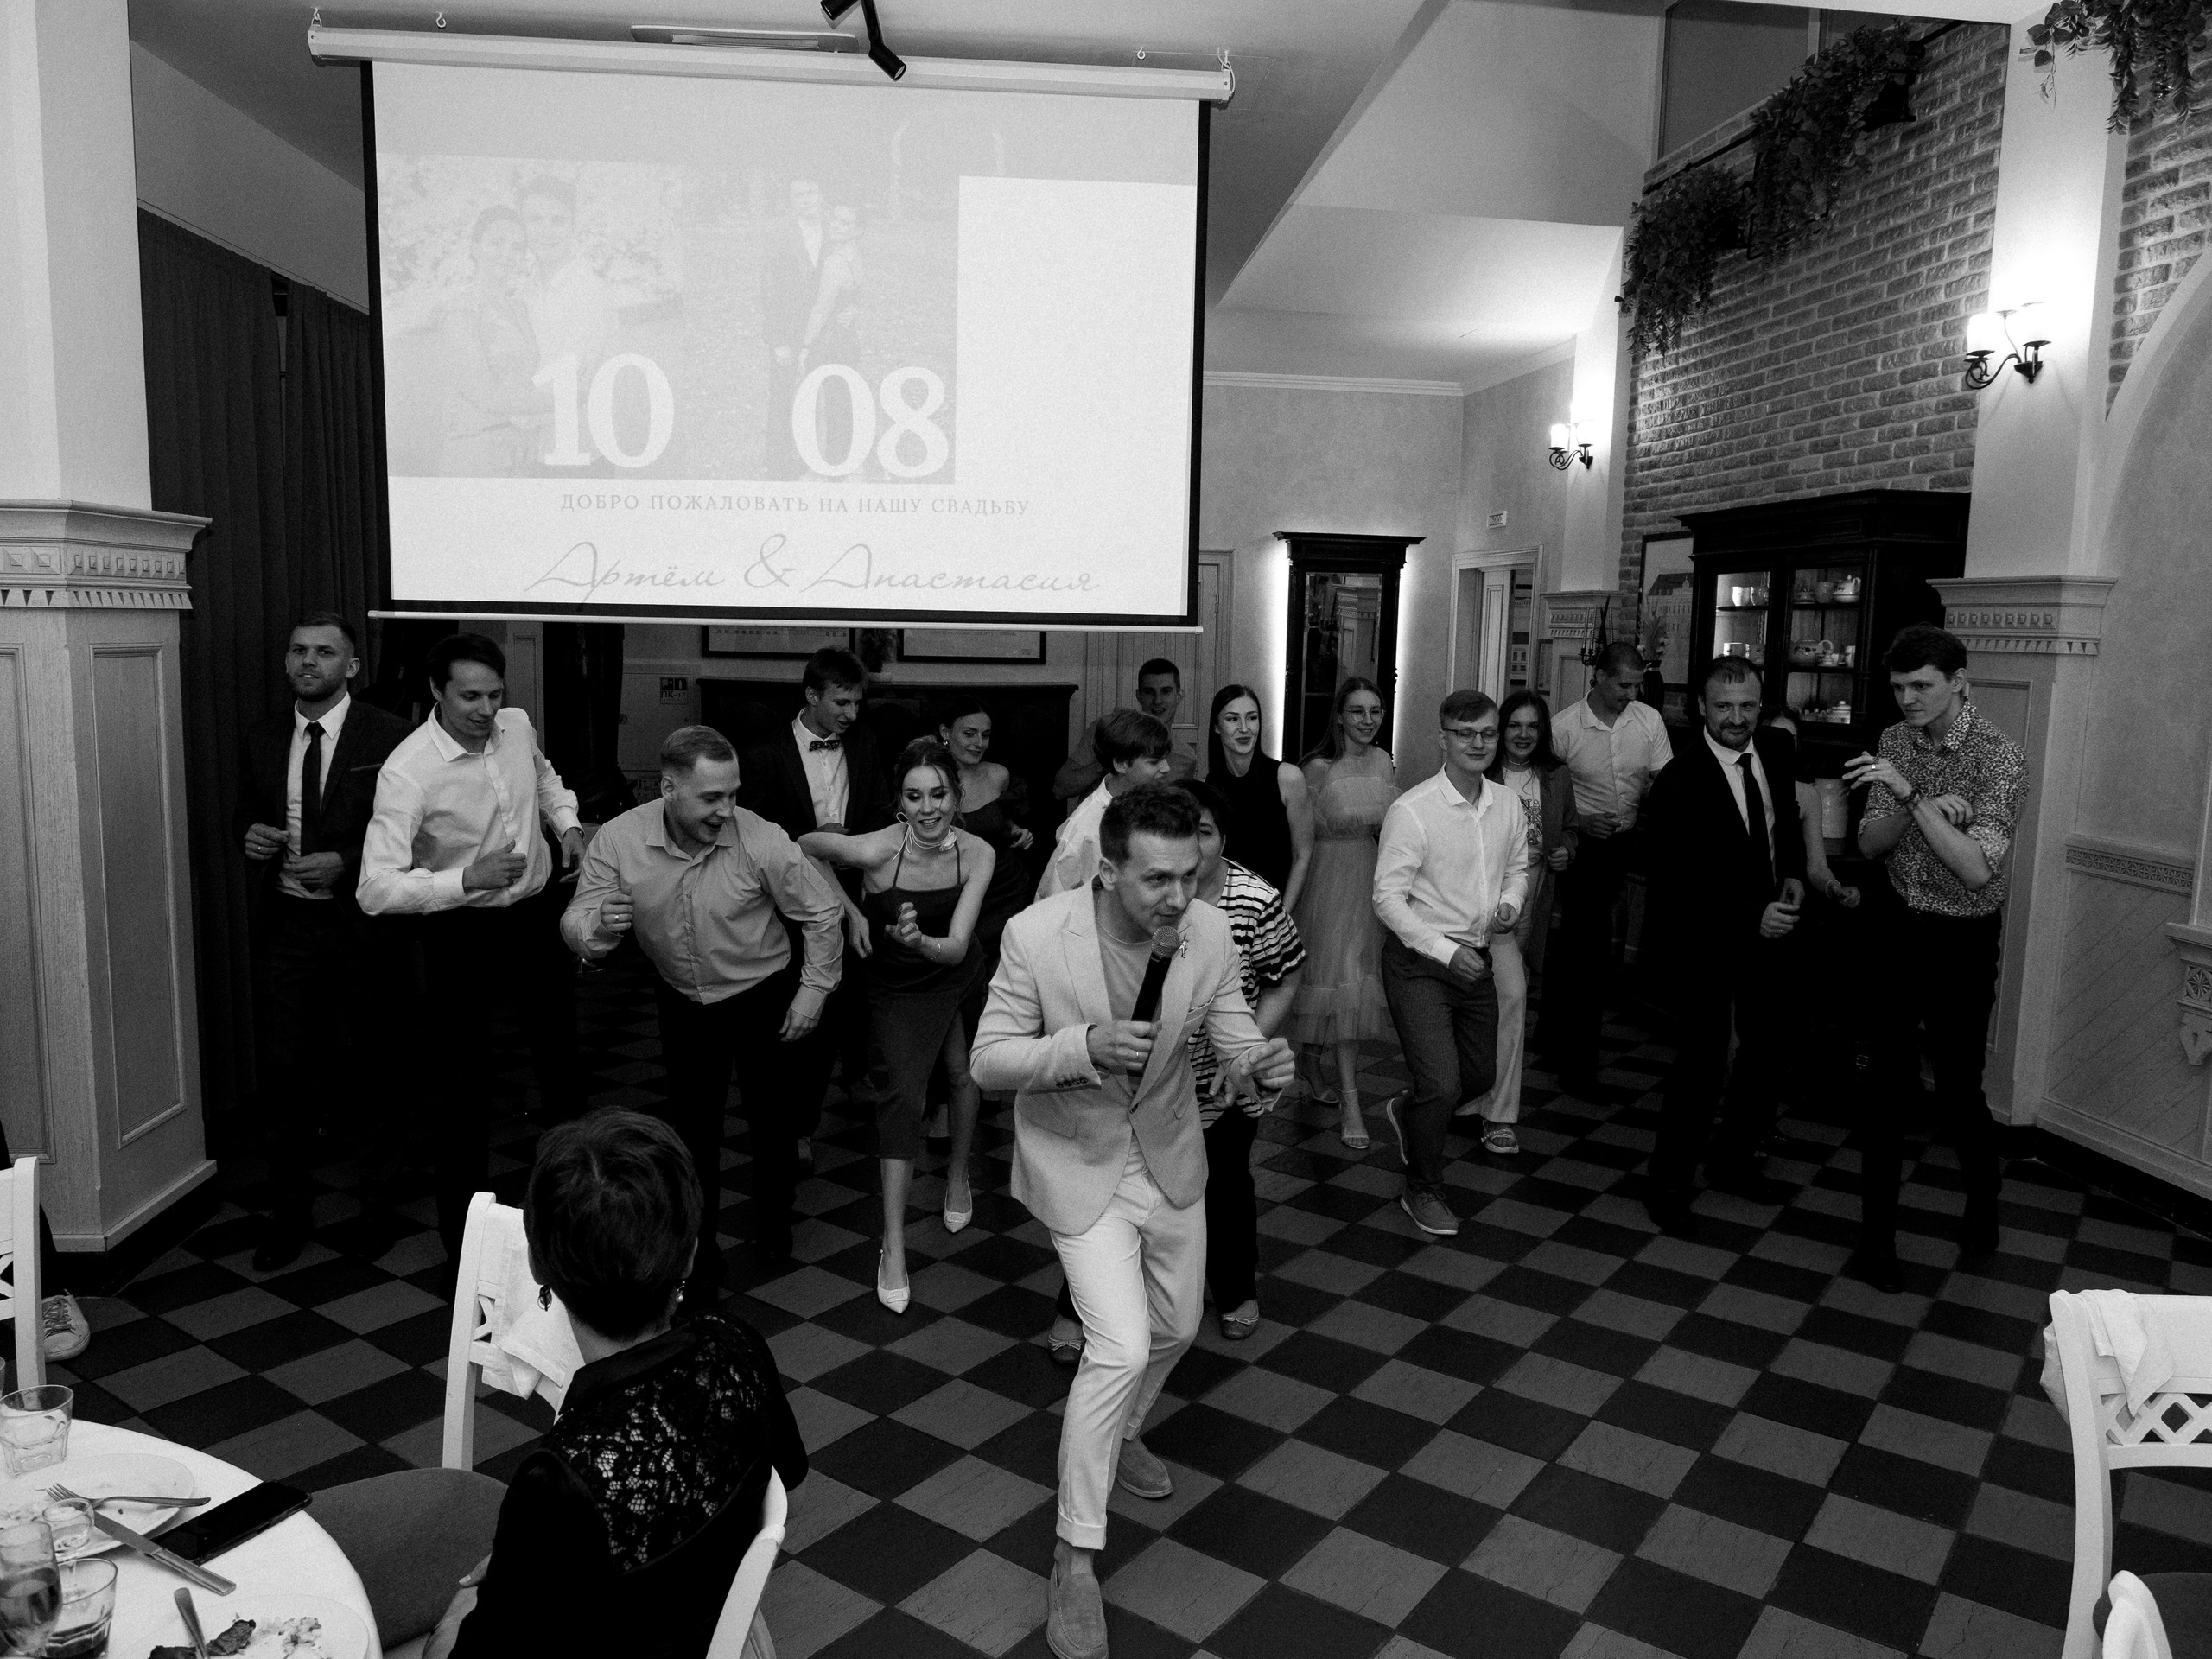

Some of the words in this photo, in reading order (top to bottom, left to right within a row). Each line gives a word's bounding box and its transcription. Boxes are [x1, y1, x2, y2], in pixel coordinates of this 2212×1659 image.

[531, 353, 674, 468] 10
[792, 364, 950, 478] 08
[561, 493, 640, 512] ДОБРО
[651, 494, 810, 512] ПОЖАЛОВАТЬ
[820, 498, 848, 512] НА
[859, 498, 923, 514] НАШУ
[931, 499, 1030, 517] СВАДЬБУ
[524, 542, 726, 605] Артём
[745, 533, 797, 588] &
[800, 543, 1099, 593] Анастасия
